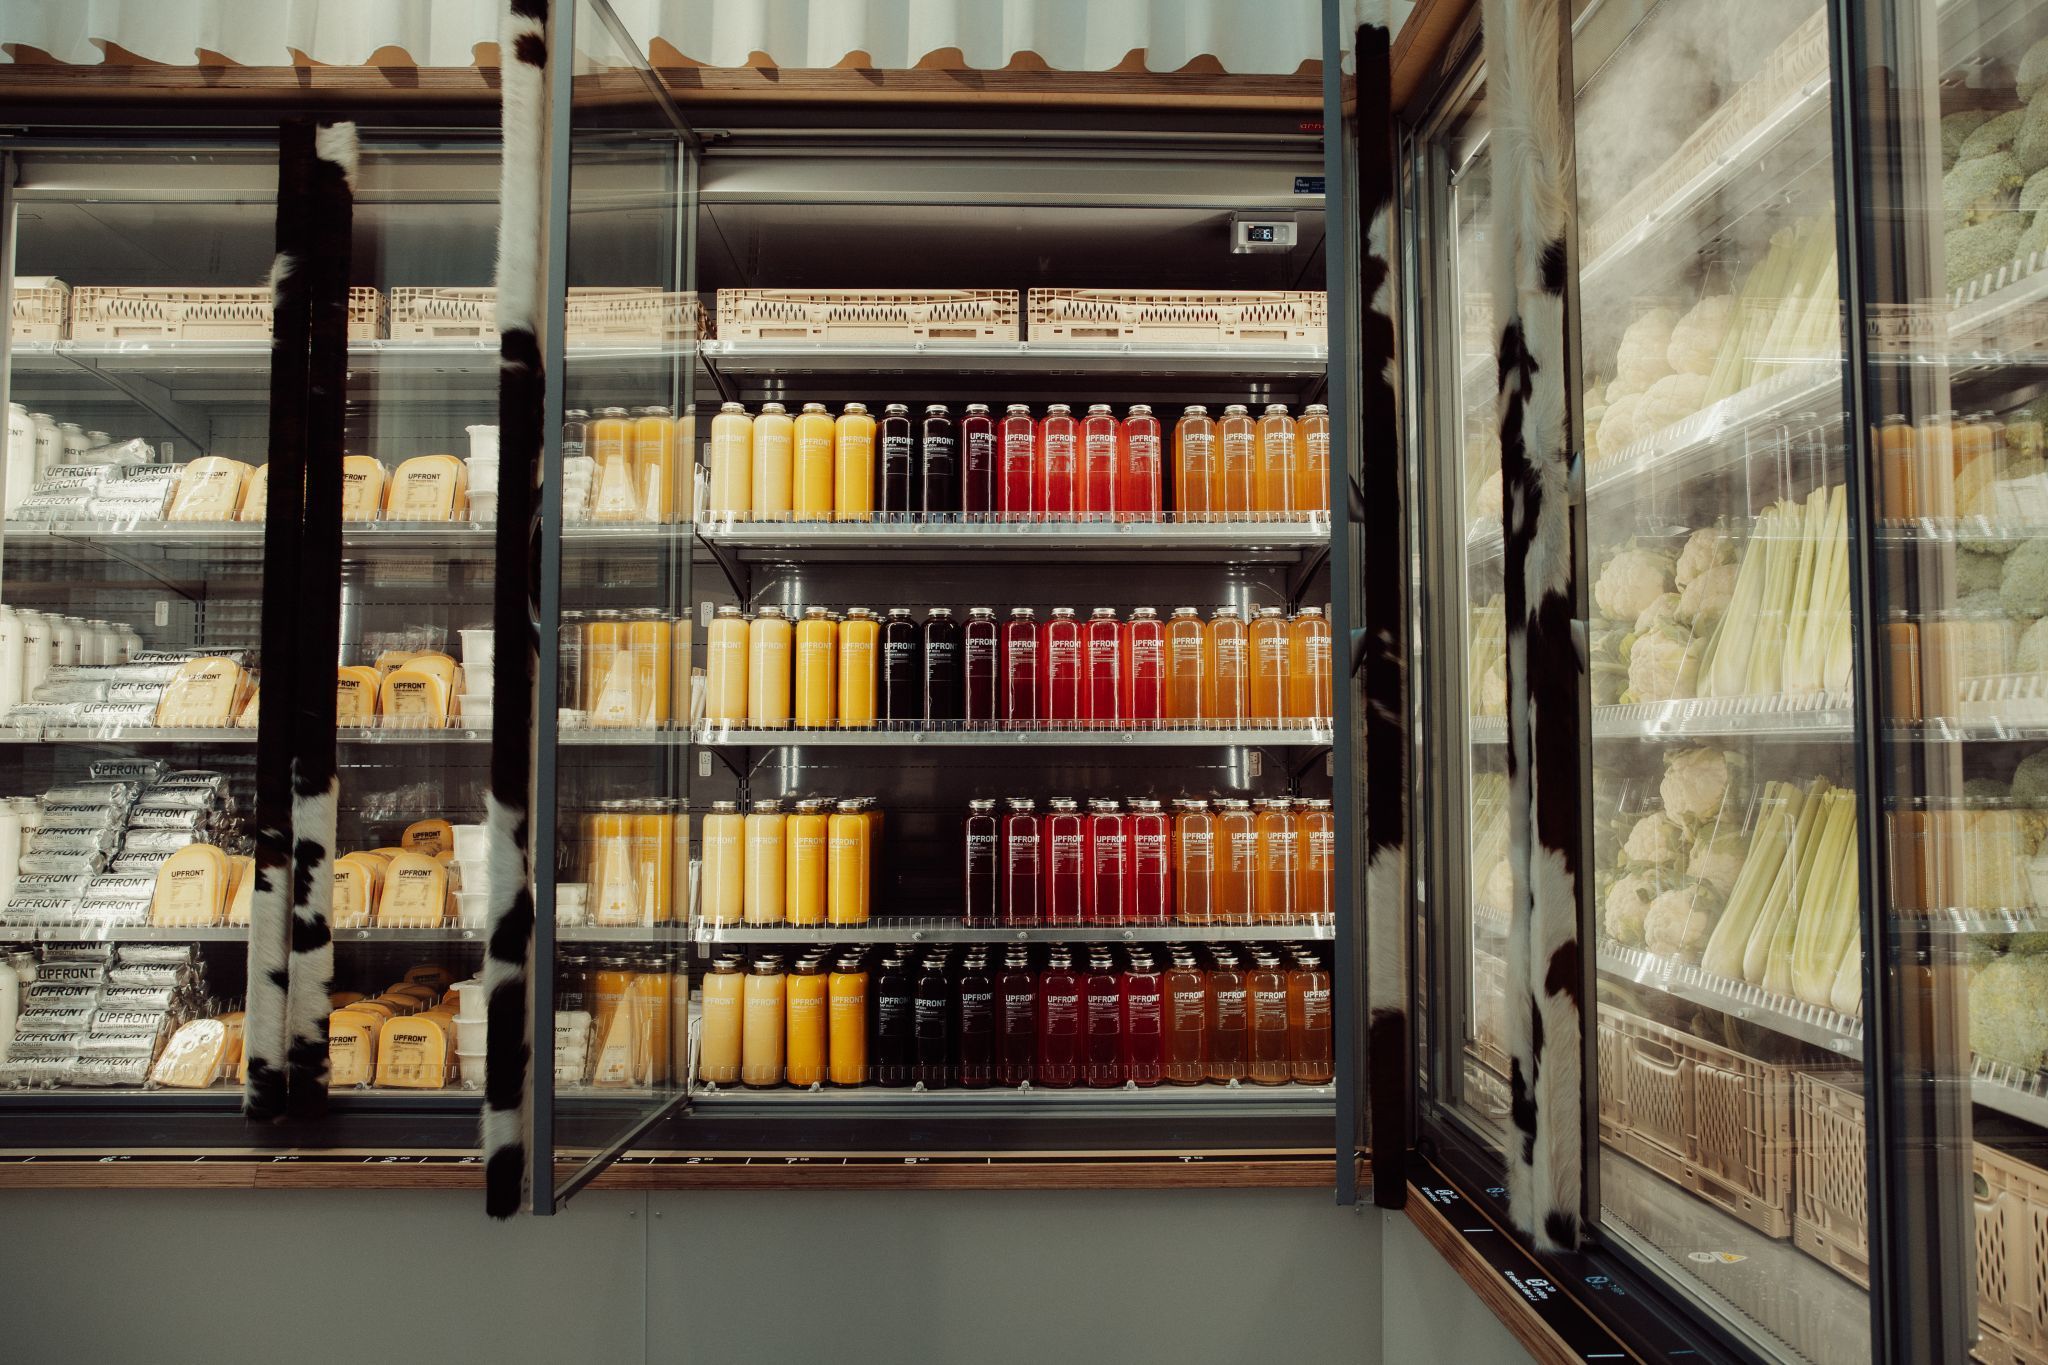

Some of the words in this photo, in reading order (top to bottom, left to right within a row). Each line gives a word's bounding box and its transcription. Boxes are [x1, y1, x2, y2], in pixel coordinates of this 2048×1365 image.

[883, 436, 914, 446] UPFRONT
[923, 436, 954, 446] UPFRONT
[1185, 433, 1215, 442] UPFRONT
[1224, 433, 1254, 441] UPFRONT
[1264, 432, 1295, 441] UPFRONT
[47, 467, 99, 477] UPFRONT
[33, 479, 86, 491] UPFRONT
[22, 497, 79, 506] UPFRONT
[966, 638, 997, 646] UPFRONT
[1050, 640, 1081, 648] UPFRONT
[1088, 640, 1119, 648] UPFRONT
[1133, 639, 1164, 647] UPFRONT
[1172, 637, 1203, 645] UPFRONT
[133, 653, 190, 662] UPFRONT
[84, 703, 145, 713] UPFRONT
[94, 764, 148, 775] UPFRONT
[134, 808, 189, 818] UPFRONT
[413, 831, 440, 839] UPFRONT
[1009, 835, 1040, 843] UPFRONT
[1053, 835, 1084, 843] UPFRONT
[1097, 835, 1127, 843] UPFRONT
[1134, 834, 1166, 843] UPFRONT
[1182, 832, 1214, 840] UPFRONT
[1267, 832, 1298, 840] UPFRONT
[117, 851, 176, 862] UPFRONT
[171, 869, 205, 878] UPFRONT
[19, 875, 78, 884] UPFRONT
[90, 877, 149, 888] UPFRONT
[7, 898, 70, 908] UPFRONT
[82, 900, 143, 911] UPFRONT
[38, 967, 97, 980] UPFRONT
[31, 985, 94, 997] UPFRONT
[1174, 990, 1205, 999] UPFRONT
[1218, 990, 1247, 999] UPFRONT
[1254, 990, 1287, 999] UPFRONT
[792, 997, 823, 1006] UPFRONT
[831, 995, 864, 1004] UPFRONT
[915, 998, 947, 1006] UPFRONT
[1047, 994, 1079, 1003] UPFRONT
[1088, 994, 1119, 1003] UPFRONT
[1128, 993, 1160, 1002] UPFRONT
[24, 1008, 86, 1017] UPFRONT
[99, 1012, 160, 1024] UPFRONT
[15, 1032, 79, 1042] UPFRONT
[393, 1034, 427, 1042] UPFRONT
